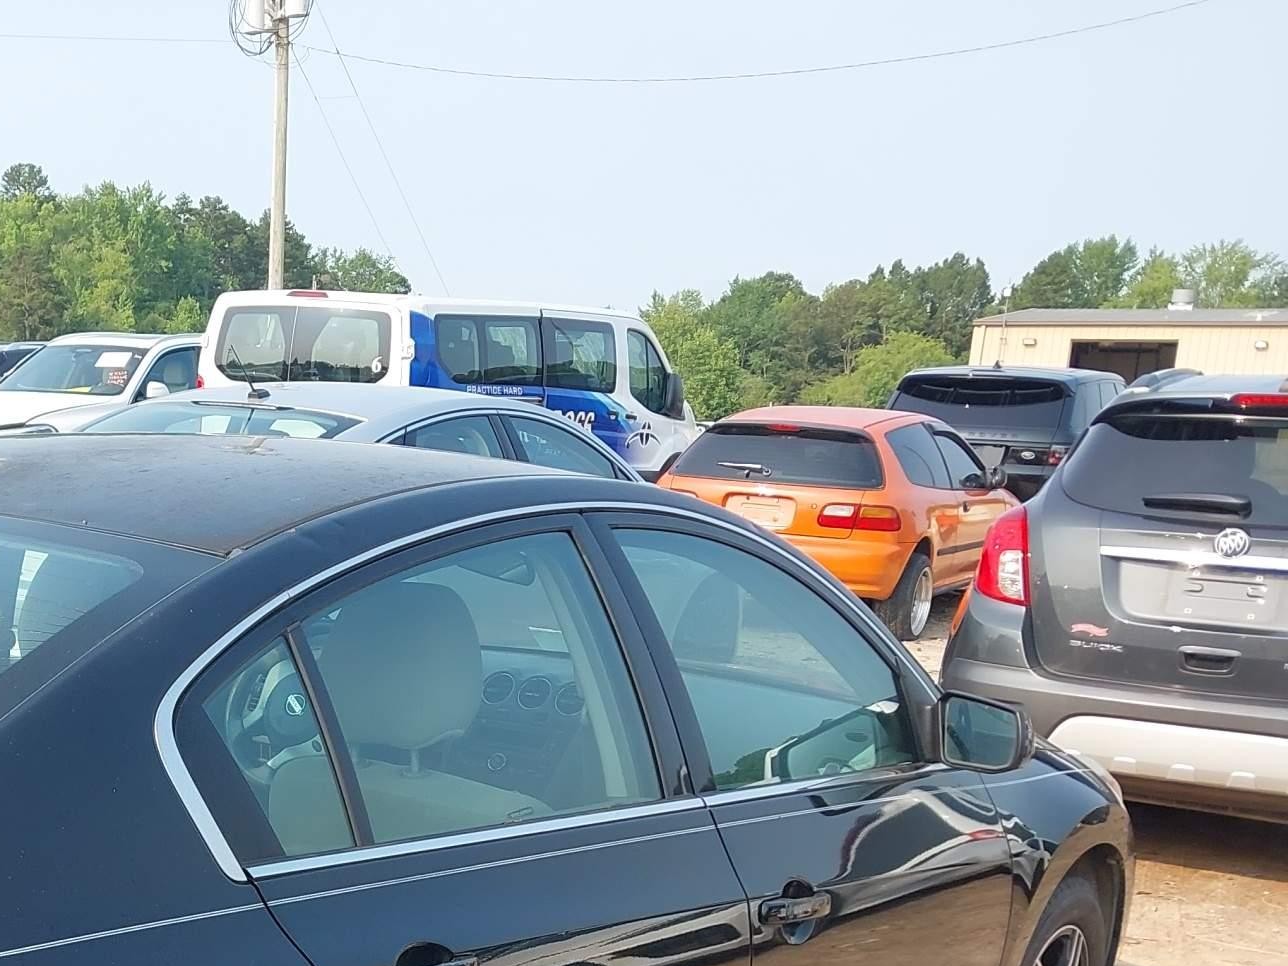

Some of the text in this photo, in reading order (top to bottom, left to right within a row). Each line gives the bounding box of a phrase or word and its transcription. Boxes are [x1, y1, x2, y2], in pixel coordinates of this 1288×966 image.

[372, 356, 383, 373] 6
[466, 385, 523, 396] PRACTICE HARD
[1069, 639, 1124, 653] BUICK
